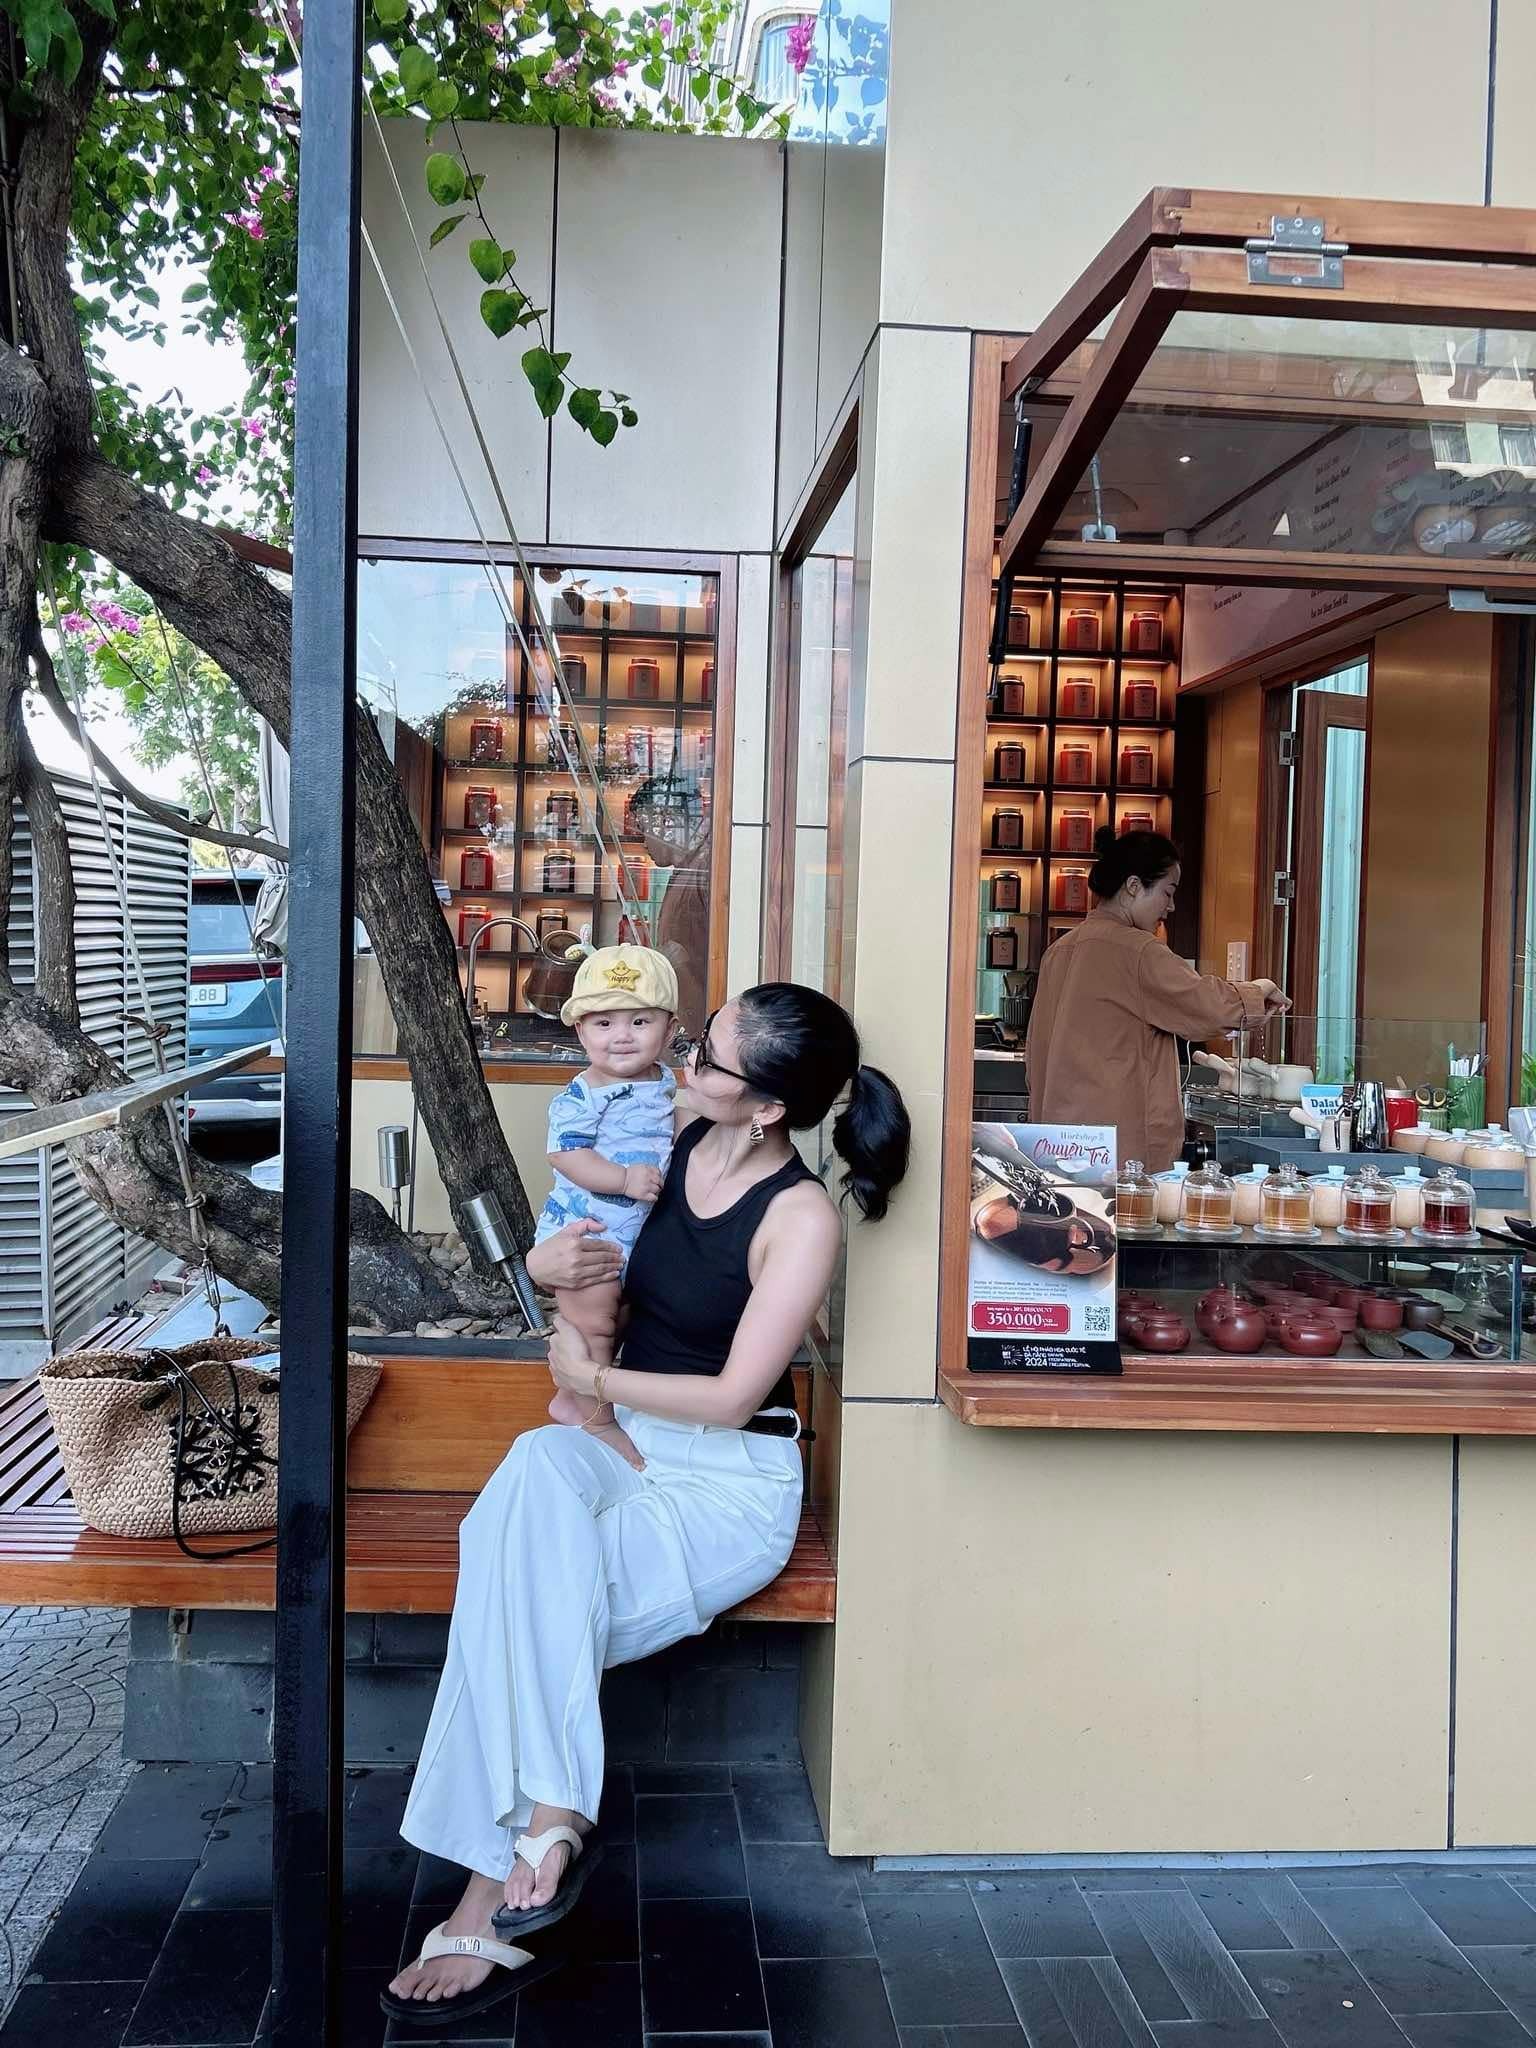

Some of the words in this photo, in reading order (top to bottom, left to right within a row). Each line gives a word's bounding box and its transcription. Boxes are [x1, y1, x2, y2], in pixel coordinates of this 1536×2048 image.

[610, 975, 630, 984] Happy
[1310, 1098, 1339, 1108] Dalat
[1084, 1146, 1111, 1168] Trà
[987, 1312, 1042, 1327] 350.000
[1024, 1357, 1048, 1367] 2024
